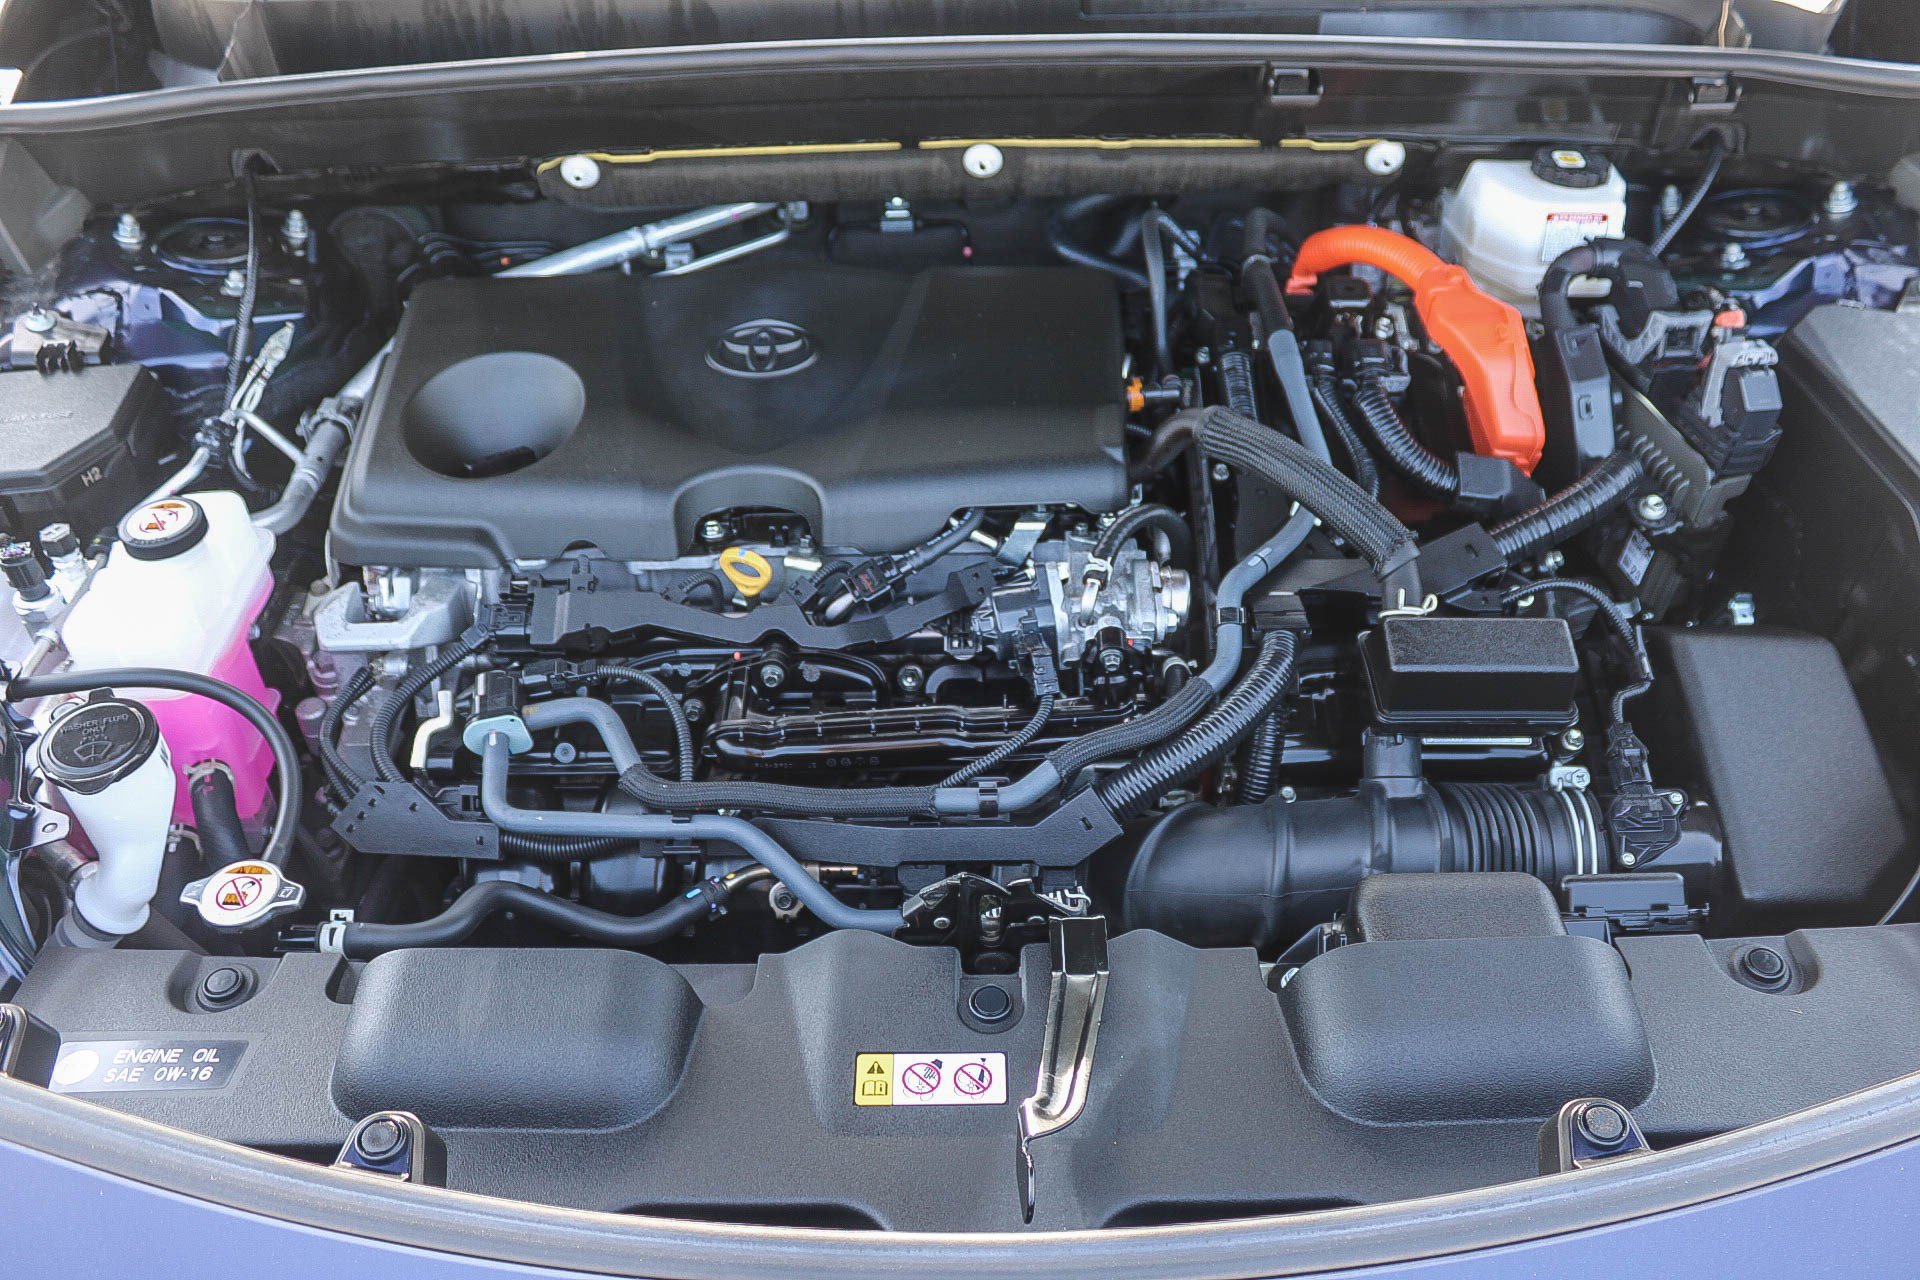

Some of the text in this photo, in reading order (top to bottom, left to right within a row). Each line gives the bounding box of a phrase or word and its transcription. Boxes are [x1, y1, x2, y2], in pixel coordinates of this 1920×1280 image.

[81, 467, 102, 487] H2
[60, 713, 129, 734] WASHER FLUID
[82, 726, 106, 735] ONLY
[114, 1048, 220, 1064] ENGINE OIL
[103, 1065, 214, 1083] SAE 0W-16
